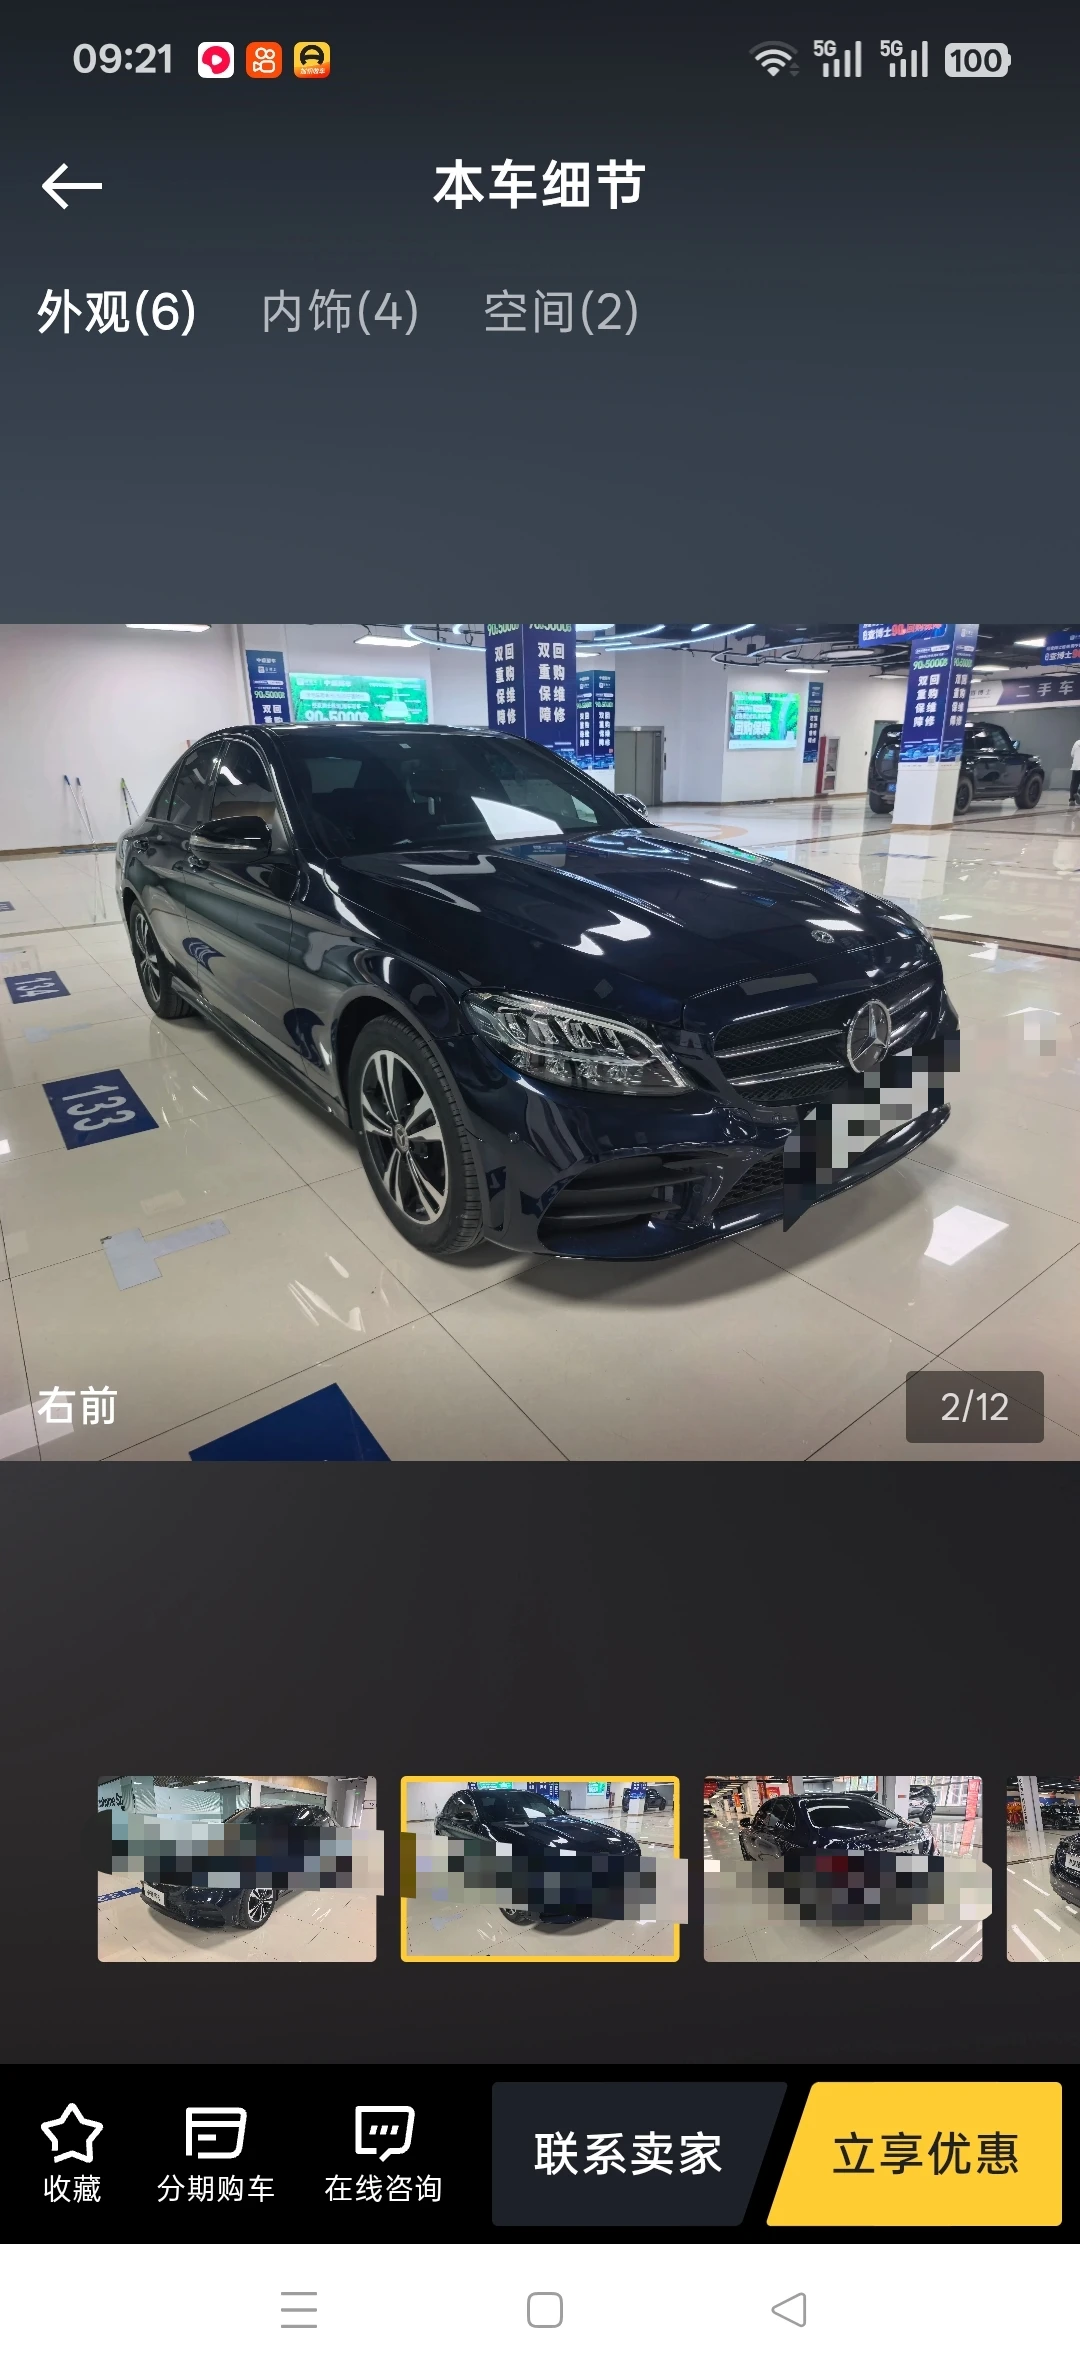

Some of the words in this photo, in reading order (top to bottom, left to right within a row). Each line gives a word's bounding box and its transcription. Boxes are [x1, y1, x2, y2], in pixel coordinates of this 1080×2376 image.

[74, 44, 171, 73] 09:21
[814, 40, 836, 57] 5G
[881, 40, 903, 57] 5G
[950, 49, 1002, 72] 100
[433, 158, 645, 209] 本车细节
[37, 289, 194, 336] 外观(6)
[262, 289, 418, 335] 内饰(4)
[484, 289, 638, 335] 空间(2)
[1016, 681, 1074, 697] 二手车
[14, 977, 60, 998] 134
[62, 1084, 136, 1133] 133
[533, 2130, 723, 2176] 联系卖家
[832, 2130, 1019, 2177] 立享优惠
[43, 2173, 102, 2204] 收藏
[156, 2173, 275, 2203] 分期购车
[324, 2173, 442, 2203] 在线咨询
